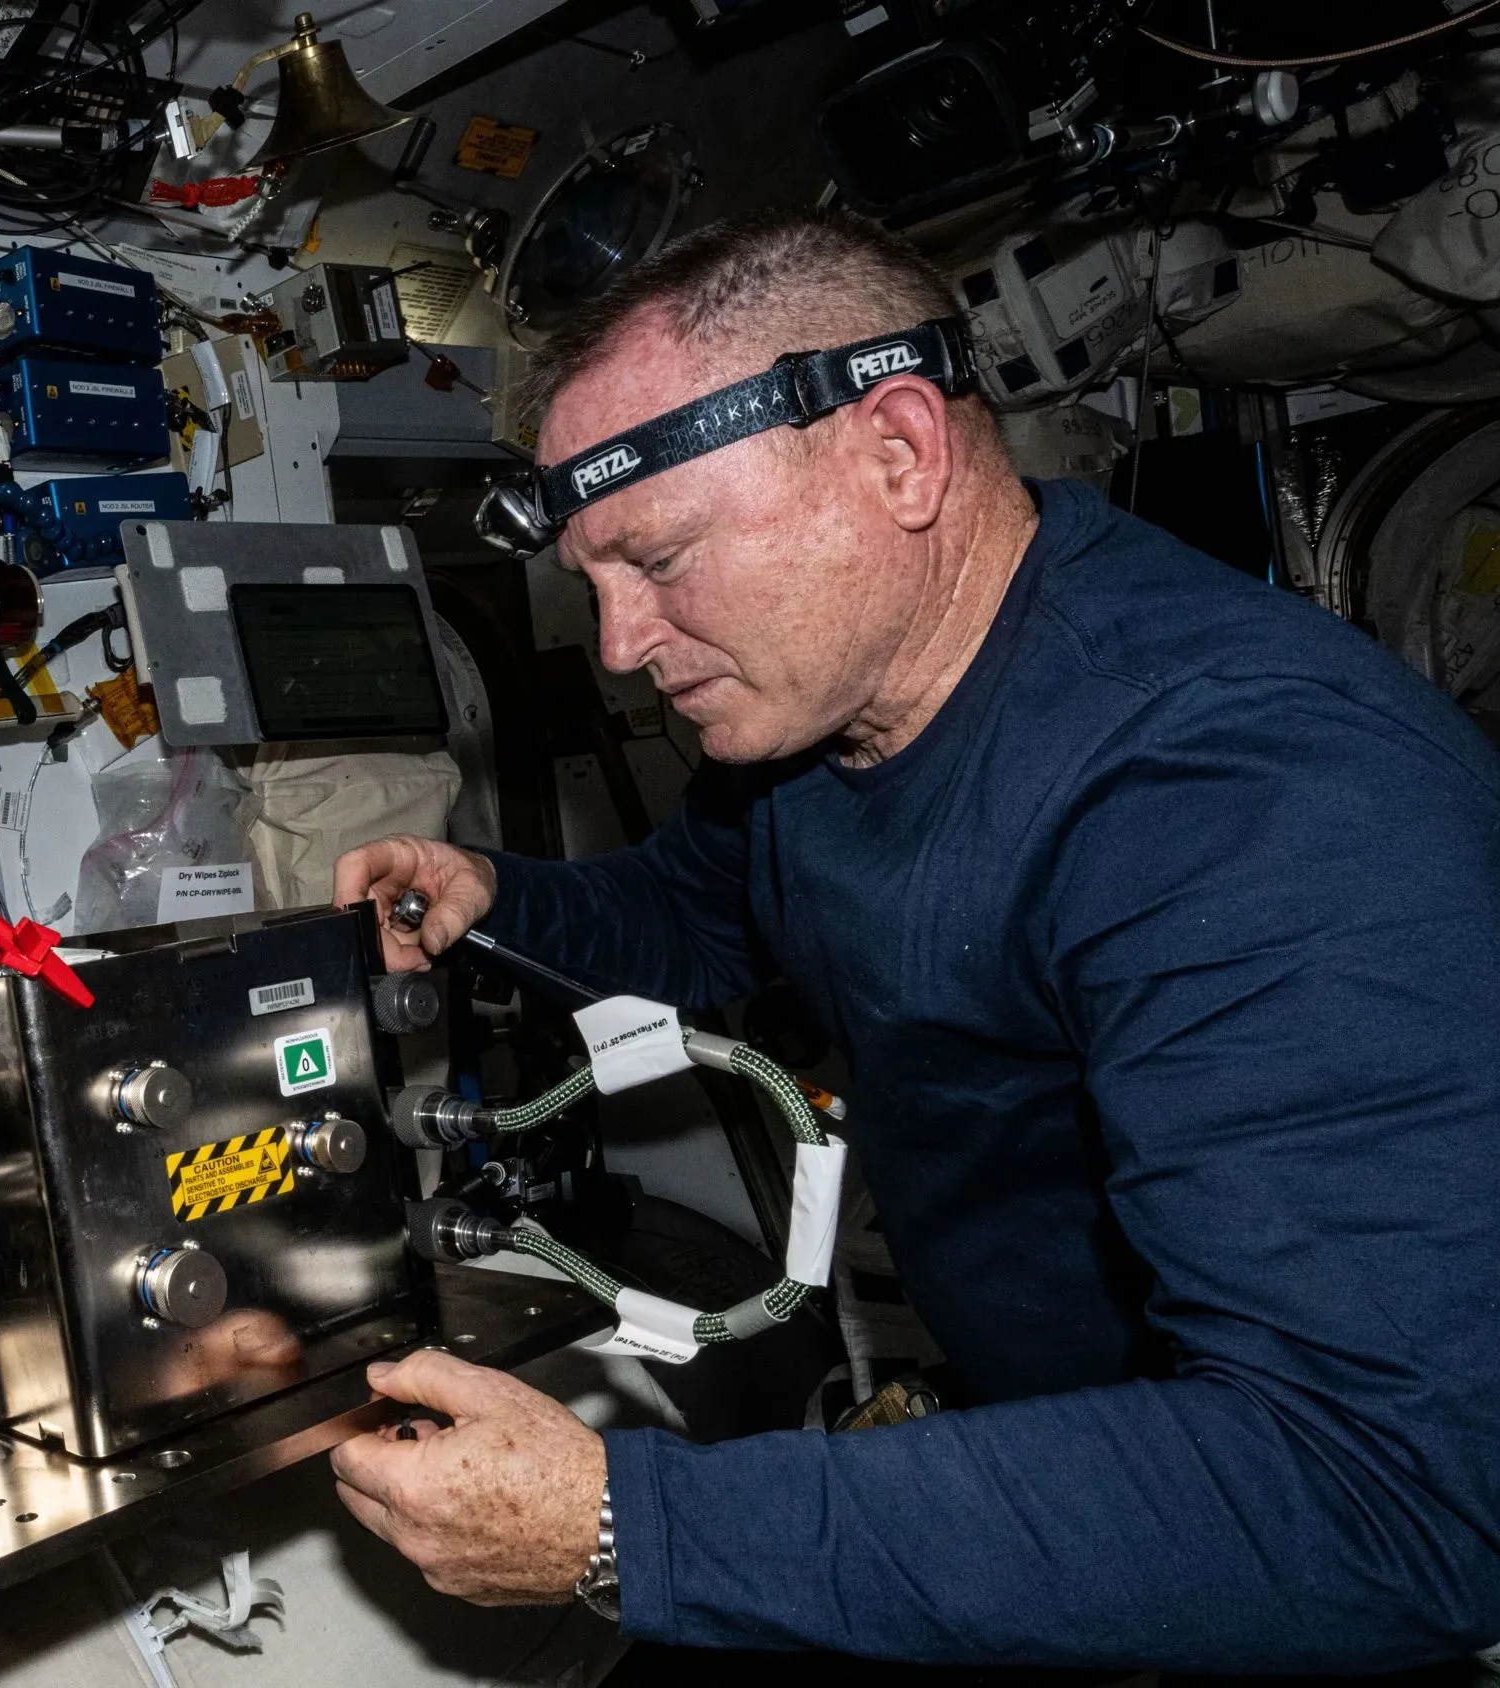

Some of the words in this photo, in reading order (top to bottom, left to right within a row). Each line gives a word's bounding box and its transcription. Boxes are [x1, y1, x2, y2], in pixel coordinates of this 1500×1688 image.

[104, 283, 129, 293] FIREWALL
[849, 341, 922, 390] PETZL
[101, 386, 129, 394] FIREWALL
[695, 389, 785, 433] TIKKA
[573, 448, 642, 499] PETZL
[130, 503, 153, 511] ROUTER
[179, 871, 192, 881] Dry
[195, 871, 216, 881] Wipes
[218, 869, 240, 879] Ziplock
[637, 1024, 652, 1034] Flex
[652, 1018, 668, 1029] UPA
[619, 1030, 637, 1041] Hose
[194, 1155, 240, 1174] CAUTION
[185, 1173, 204, 1185] PARTS
[205, 1170, 218, 1179] AND
[218, 1160, 255, 1175] ASSEMBLIES
[186, 1180, 216, 1194] SENSITIVE
[187, 1184, 235, 1203] ELECTROSTATIC
[235, 1174, 268, 1189] DISCHARGE
[614, 1335, 628, 1344] UPA
[628, 1340, 641, 1349] Flex
[642, 1345, 659, 1354] Hose
